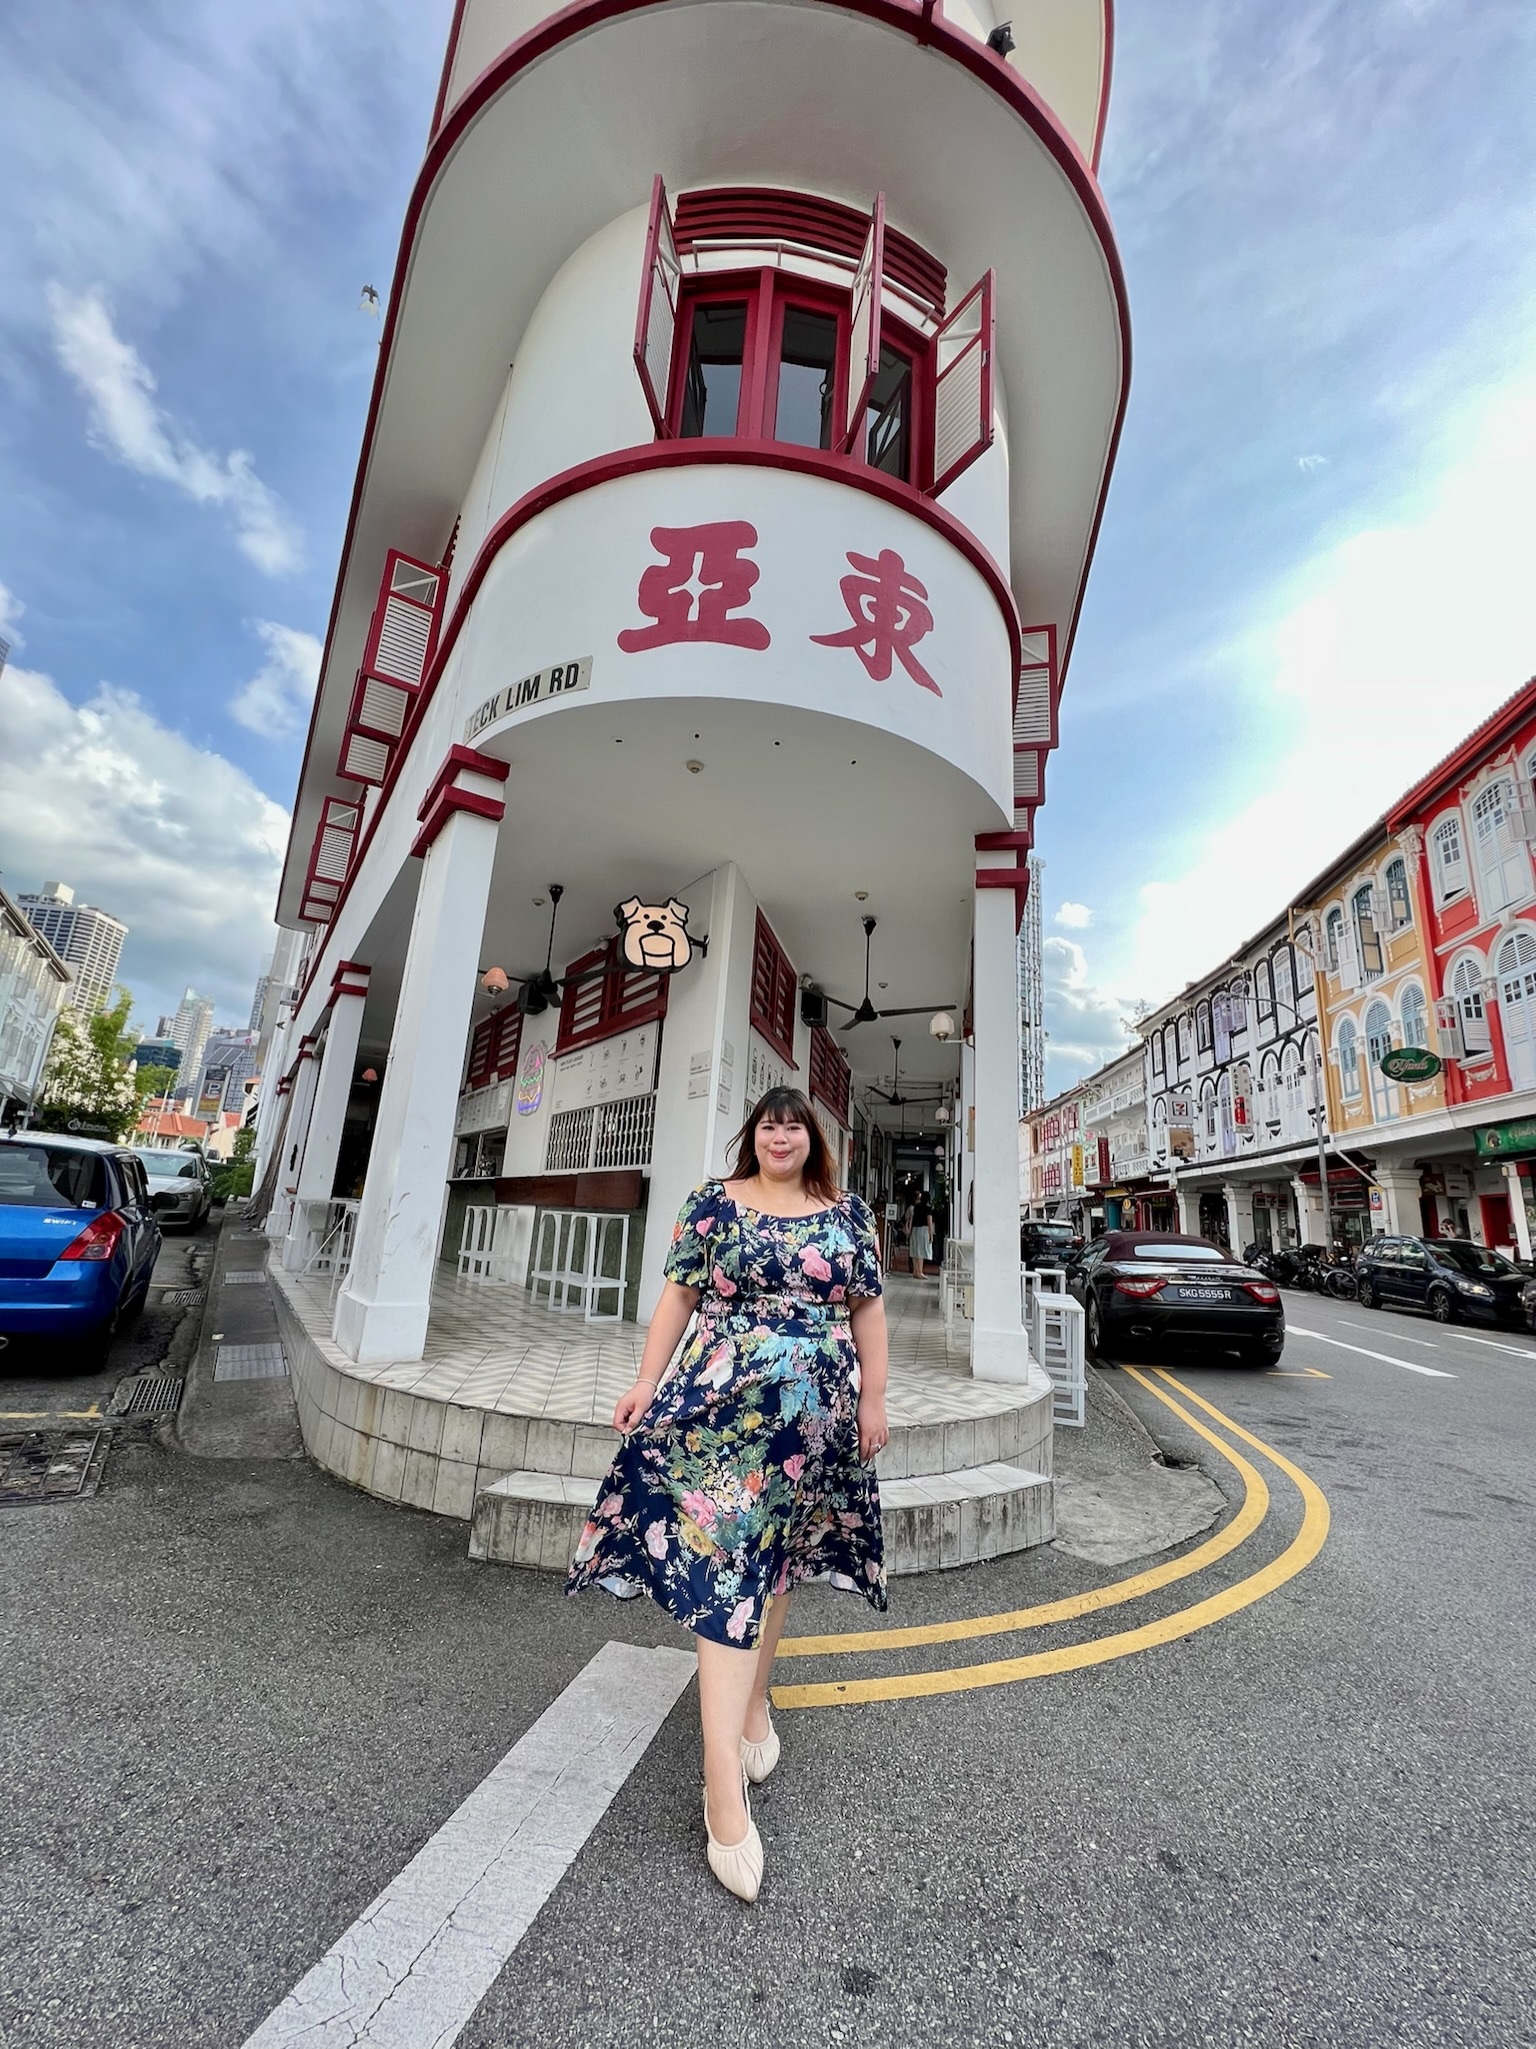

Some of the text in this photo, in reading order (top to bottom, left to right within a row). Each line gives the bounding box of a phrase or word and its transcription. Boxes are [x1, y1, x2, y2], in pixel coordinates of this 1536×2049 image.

[468, 663, 579, 739] TECK LIM RD
[43, 1217, 77, 1226] SWIFT
[1179, 1288, 1232, 1300] SKG5555R
